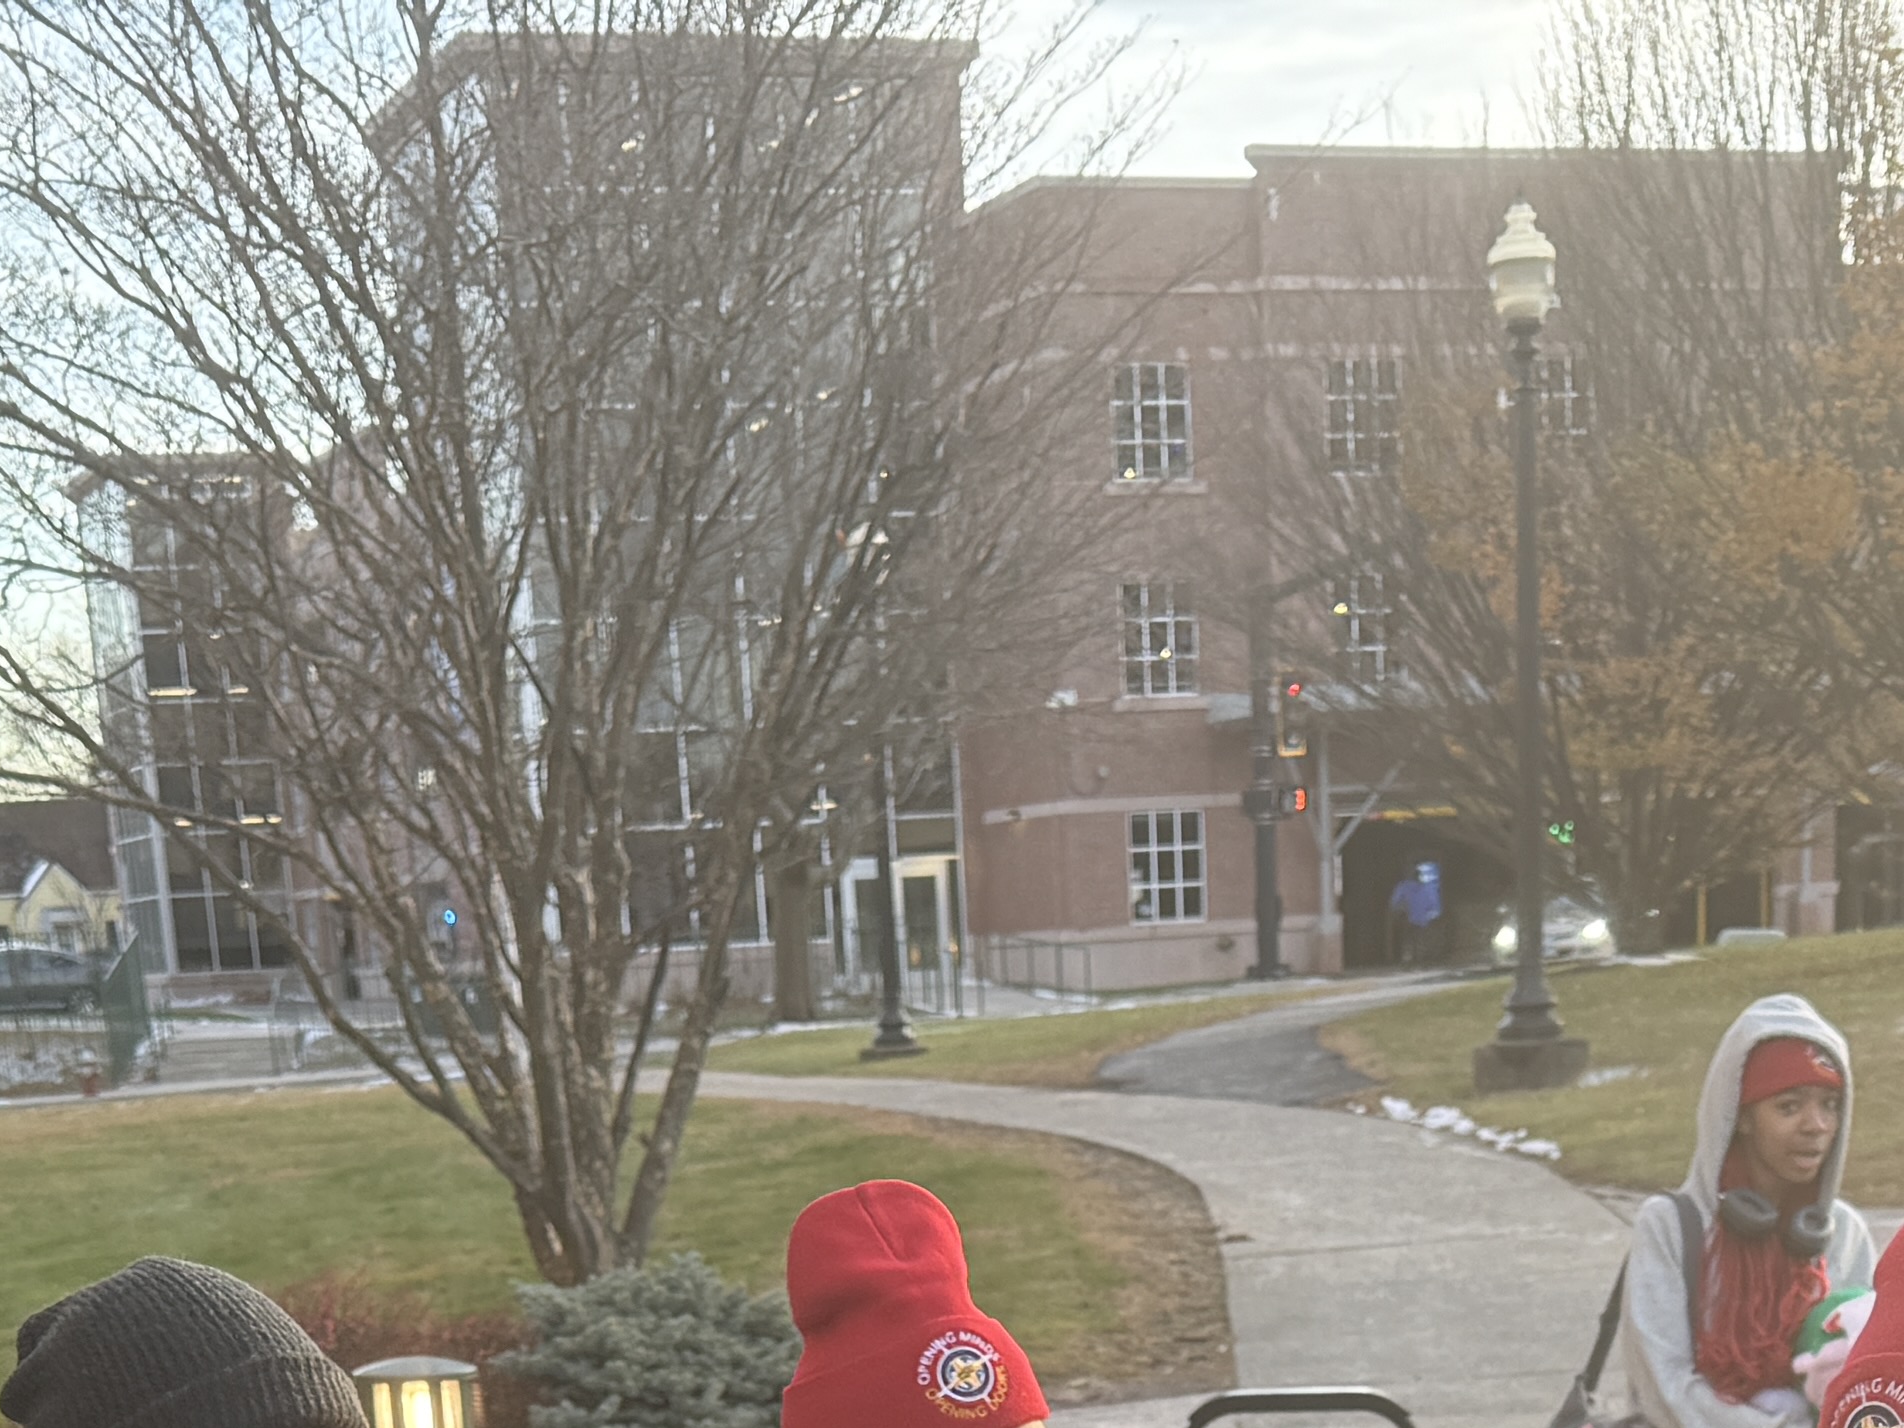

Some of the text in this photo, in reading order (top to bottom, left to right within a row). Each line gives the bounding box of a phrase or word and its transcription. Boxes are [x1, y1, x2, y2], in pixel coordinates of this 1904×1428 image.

[917, 1331, 957, 1385] OPENING
[959, 1331, 1001, 1362] MINDS
[925, 1388, 988, 1419] OPENING
